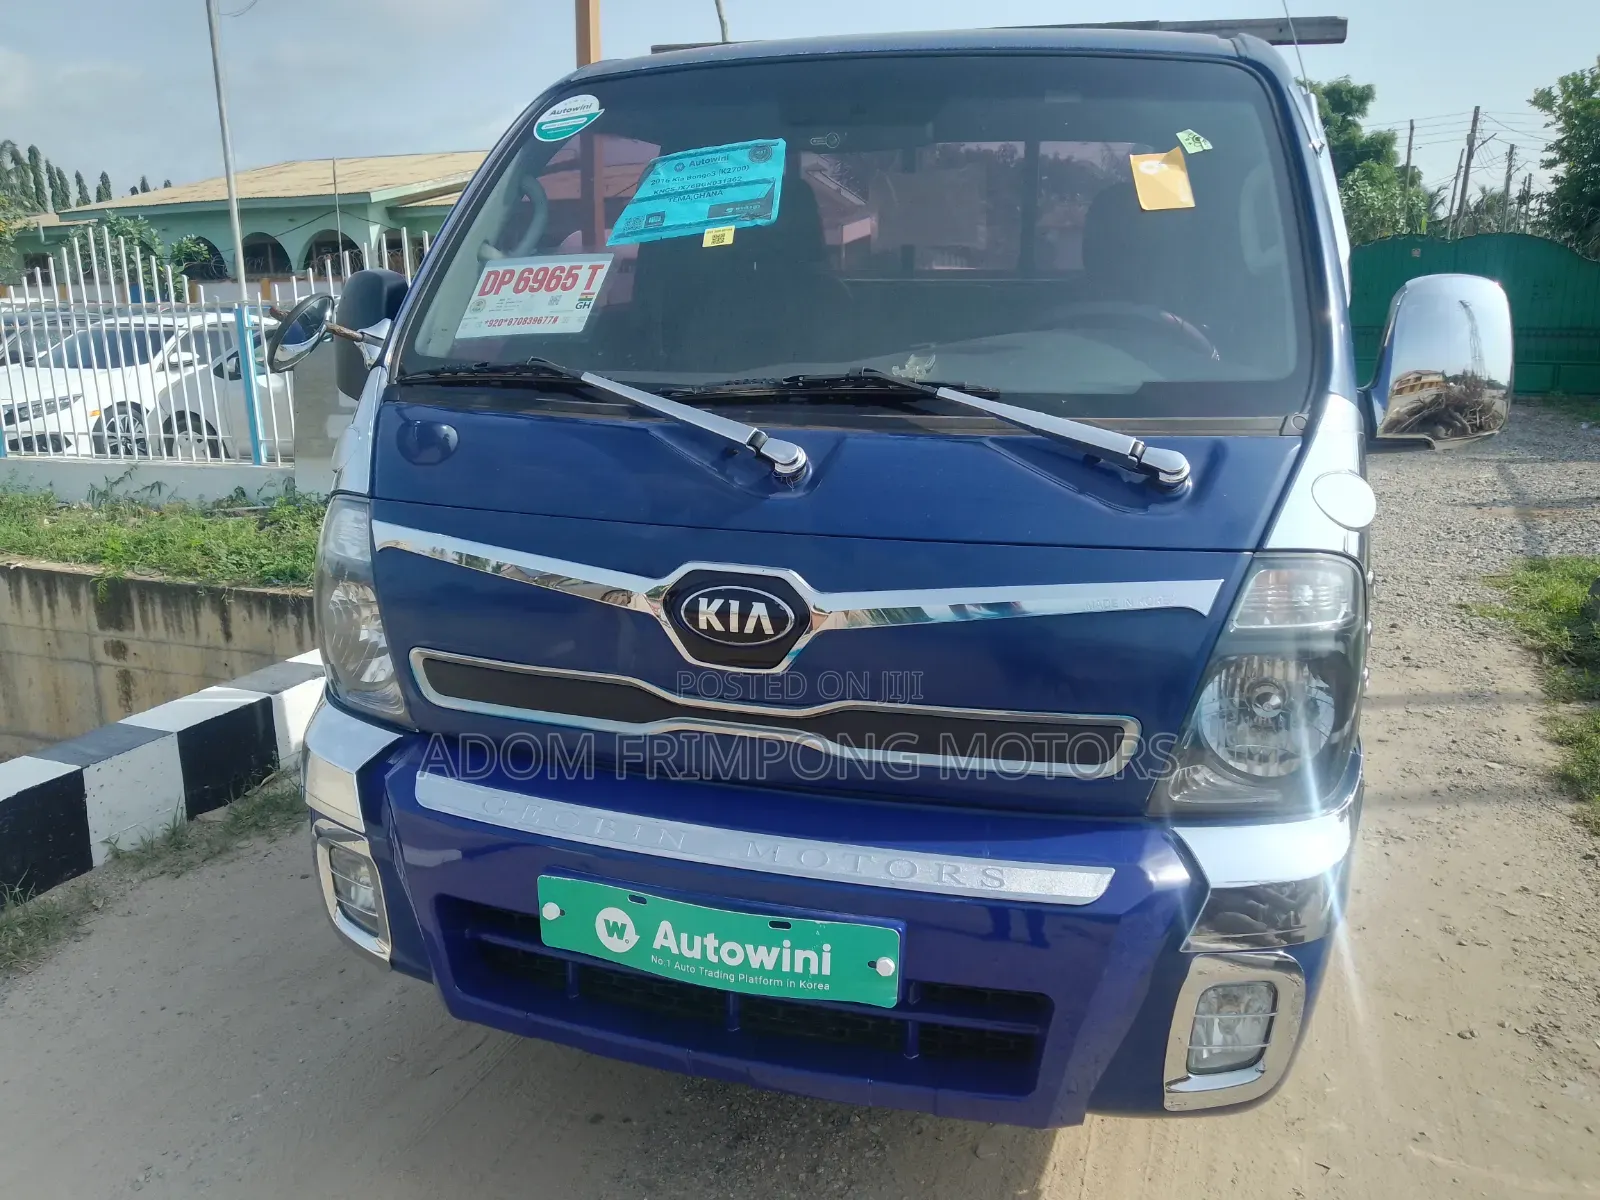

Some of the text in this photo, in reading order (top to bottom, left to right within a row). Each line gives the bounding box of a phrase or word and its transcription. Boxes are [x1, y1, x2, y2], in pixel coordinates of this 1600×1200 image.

[548, 102, 593, 116] Autowini
[651, 178, 671, 186] 2016
[686, 170, 717, 181] Bongo3
[717, 164, 750, 177] (K2700)
[688, 154, 729, 168] Autowini
[478, 264, 605, 297] DP 6965 T
[575, 301, 592, 310] GH
[698, 597, 775, 635] KIA
[743, 840, 1006, 889] MOTORS
[652, 920, 832, 976] Autowini
[650, 954, 831, 991] No.1 Auto Trading Platform in Korea
